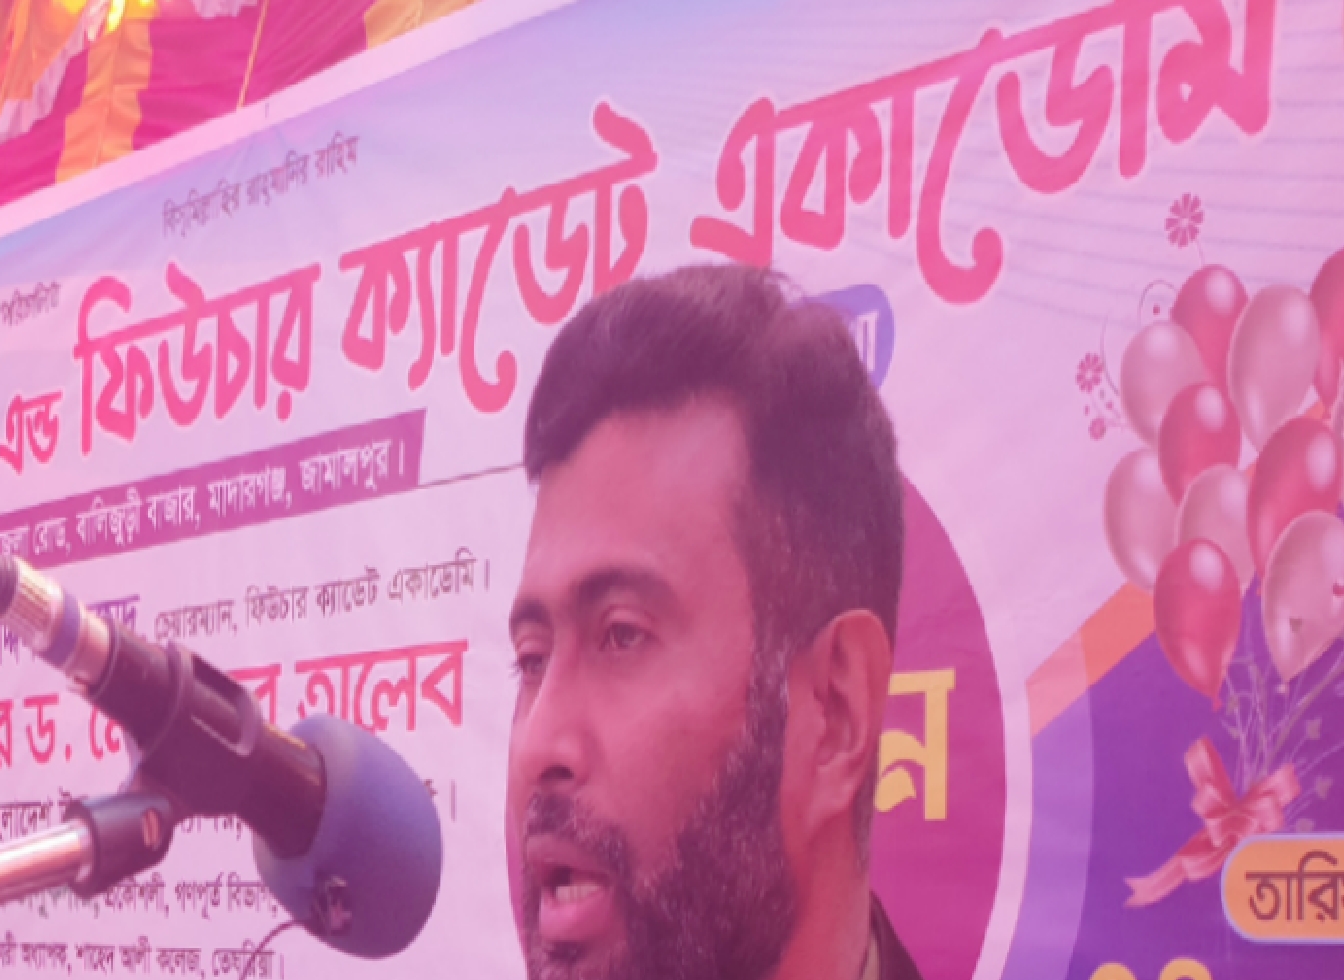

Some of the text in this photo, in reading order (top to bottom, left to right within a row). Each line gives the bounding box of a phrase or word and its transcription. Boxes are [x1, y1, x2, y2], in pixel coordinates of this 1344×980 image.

[74, 262, 321, 454] ফিউচার
[339, 101, 658, 412] ক্যাডেট
[245, 586, 309, 627] ফিউচার
[315, 565, 380, 617] ক্যাডেট
[24, 694, 72, 763] ড.
[295, 640, 468, 733] তালেব
[1244, 849, 1344, 922] তারি
